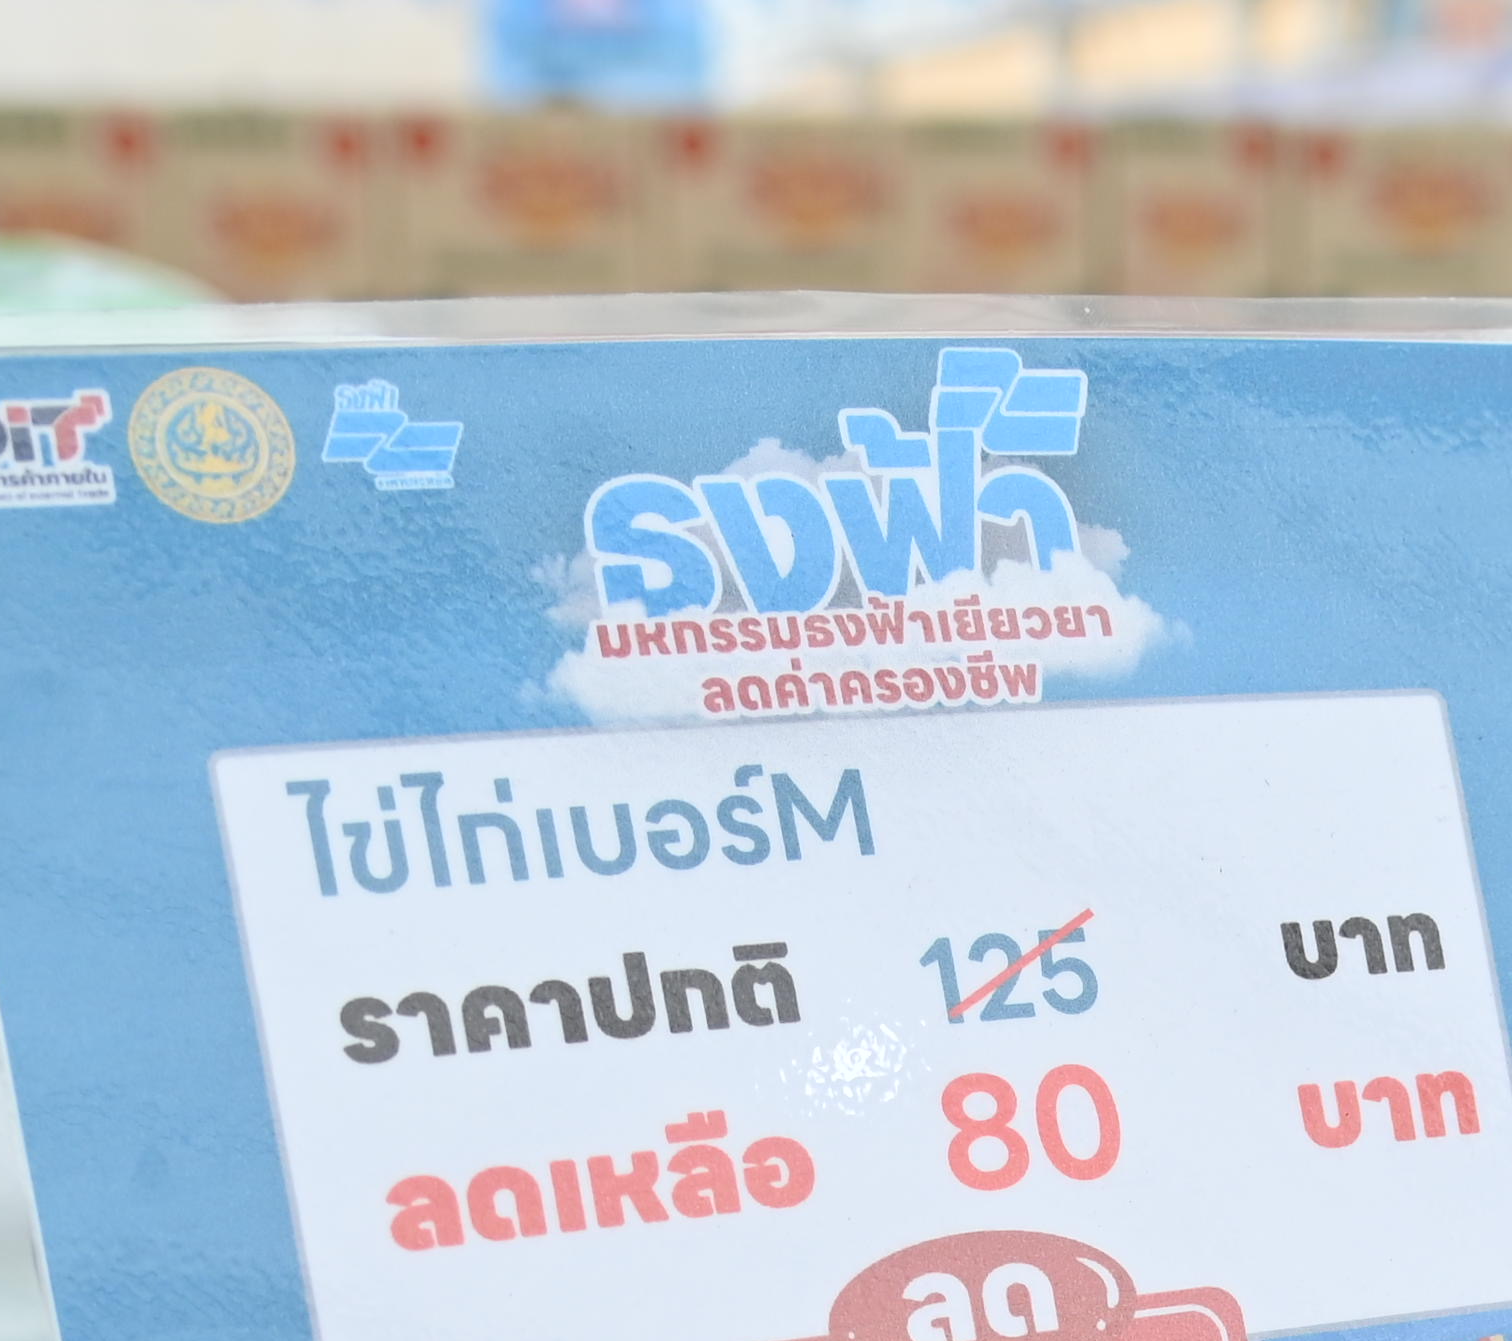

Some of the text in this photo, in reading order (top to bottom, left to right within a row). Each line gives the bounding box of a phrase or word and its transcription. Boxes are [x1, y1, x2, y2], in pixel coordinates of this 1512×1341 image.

[585, 347, 1087, 616] ธงฟ้า
[595, 594, 1114, 658] มหกรรมธงฟ้าเยียวยา
[701, 651, 1038, 714] ลดค่าครองชีพ
[286, 763, 876, 898] ไข่ไก่เบอร์M
[339, 908, 1446, 1065] ราคาปกติ 125 บาท
[385, 1063, 1481, 1252] ลดเหลือ 80 บาท
